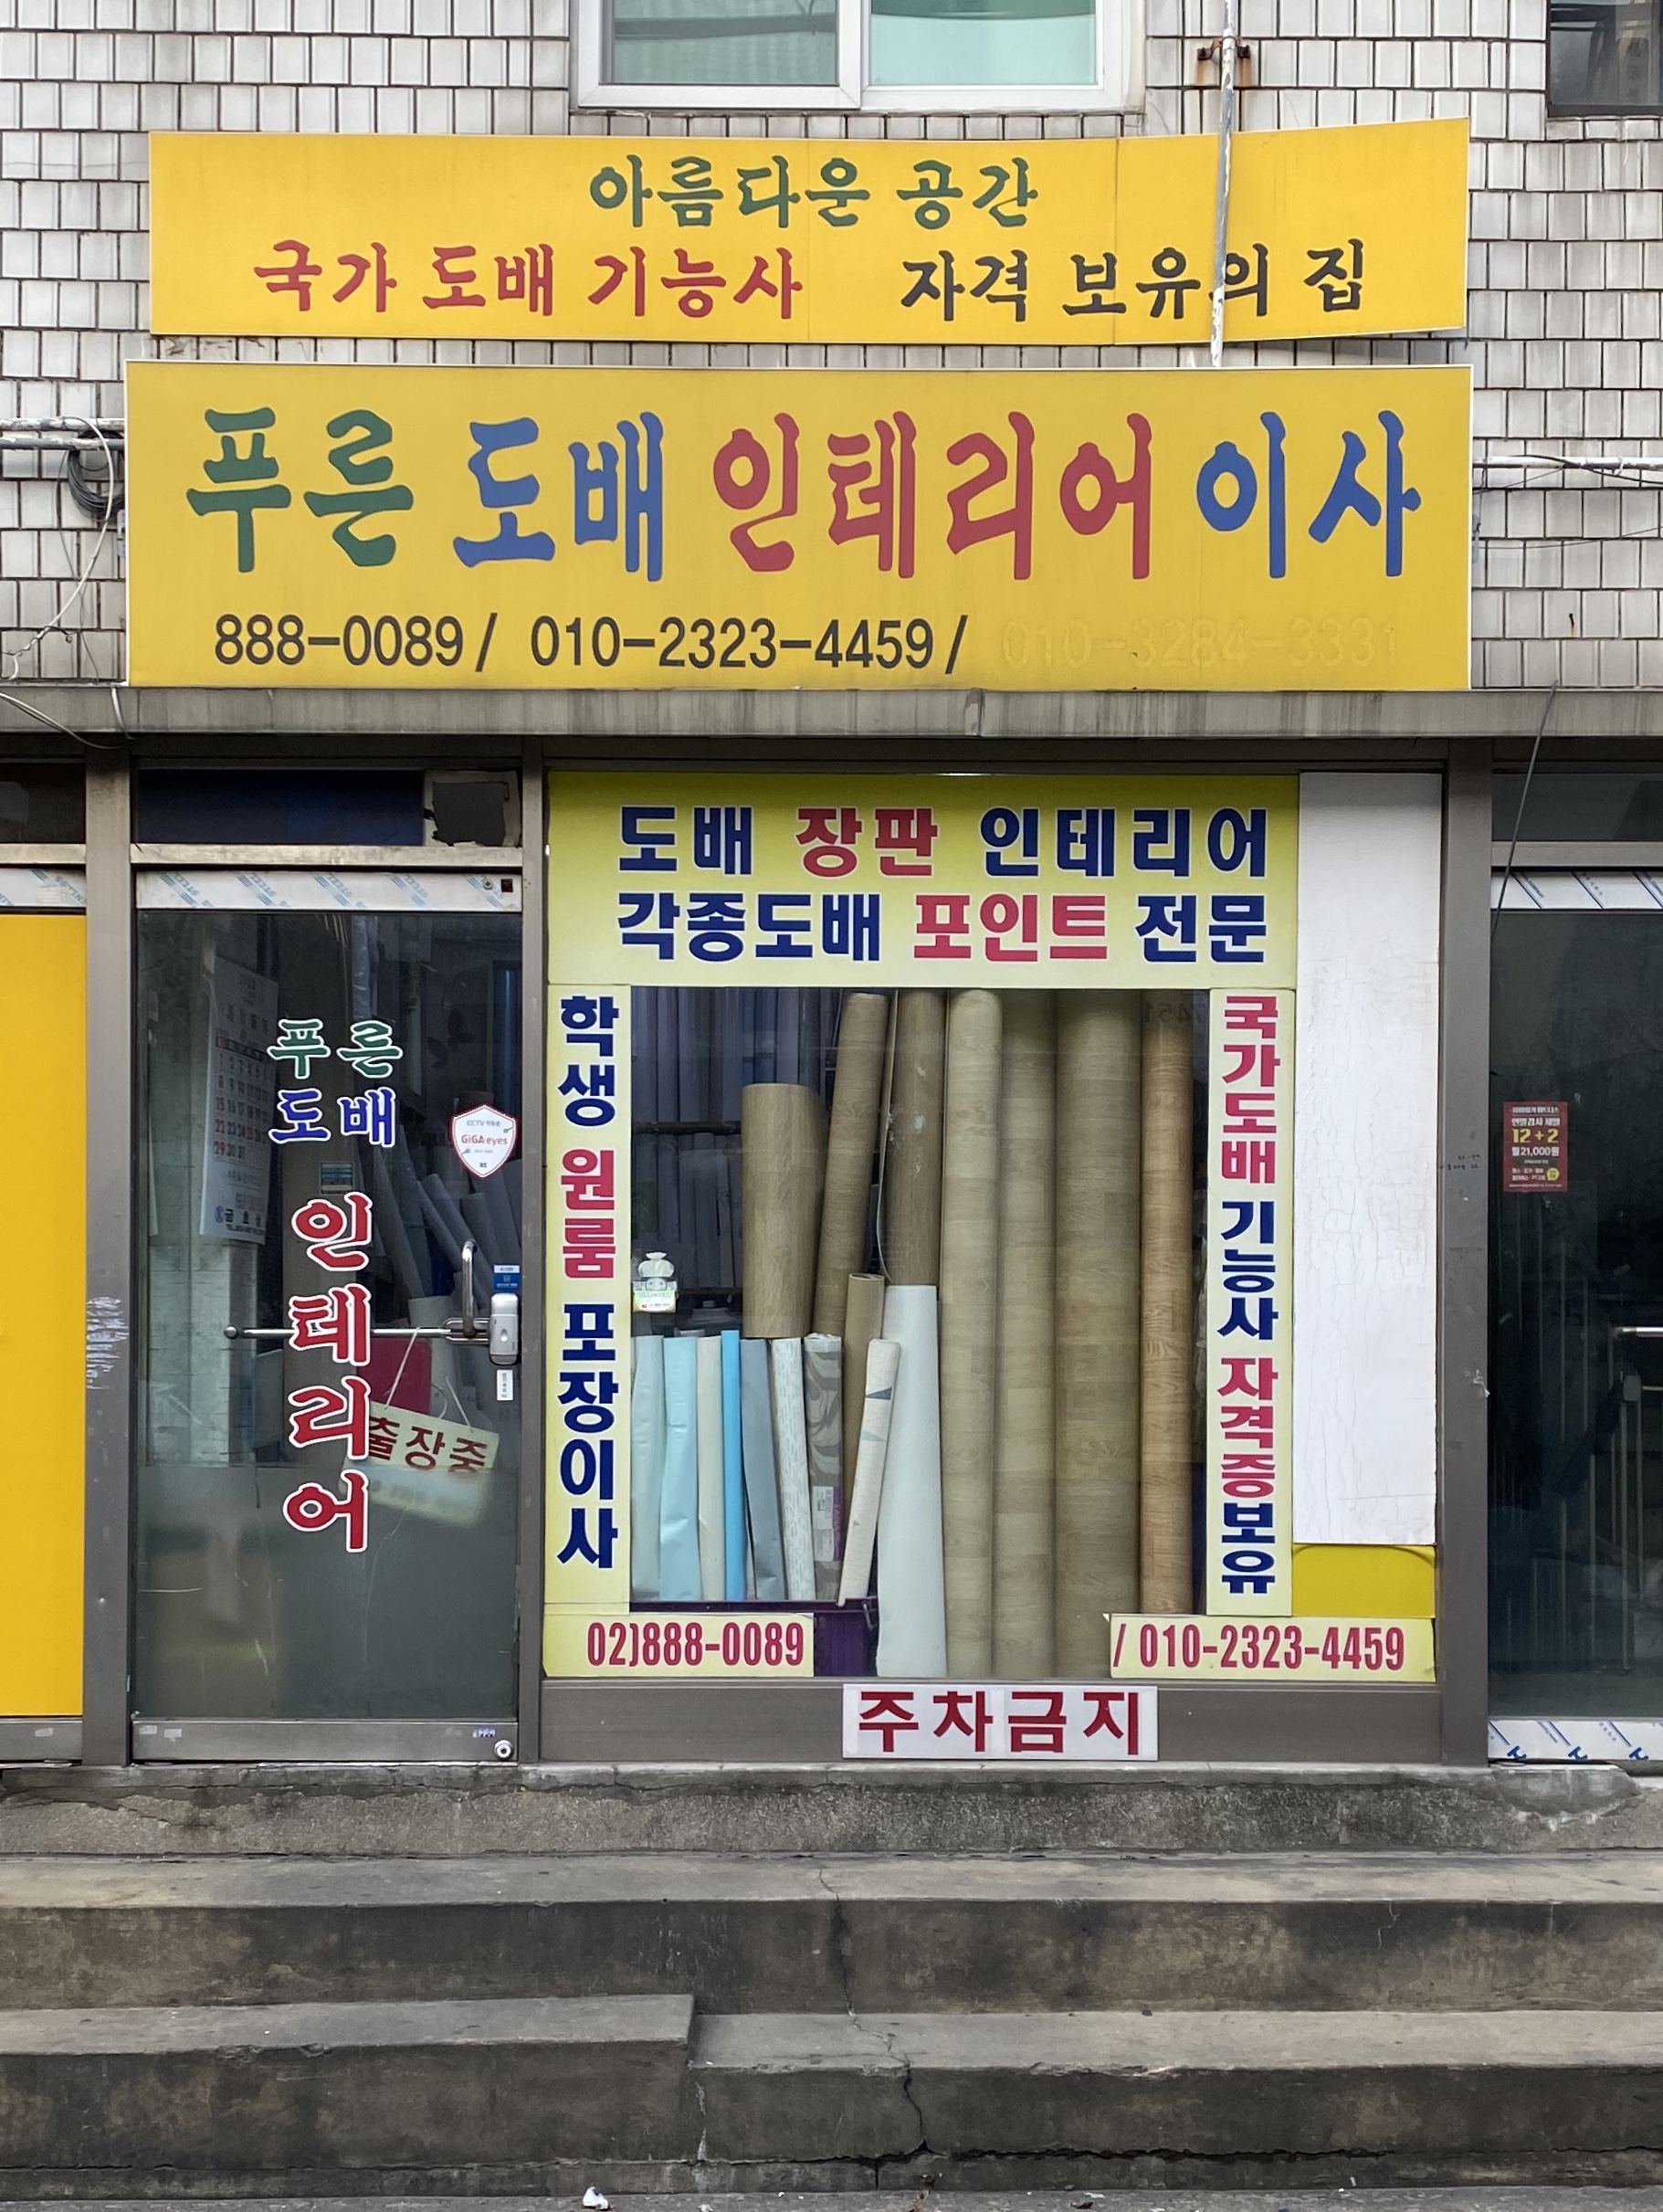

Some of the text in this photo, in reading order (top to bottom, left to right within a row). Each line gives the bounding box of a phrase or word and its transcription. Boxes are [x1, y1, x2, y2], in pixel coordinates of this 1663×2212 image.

[589, 154, 1037, 229] 아름다운 공간
[253, 239, 396, 312] 국가
[422, 243, 553, 316] 도배
[586, 246, 803, 320] 기능사
[900, 248, 1028, 322] 자격
[1303, 238, 1363, 312] 집
[186, 406, 1421, 582] 푸른 도배 인테리어 이사
[618, 805, 1268, 879] 도배 장판 인테리어
[617, 892, 1266, 963] 각종도배 포인트 전문
[267, 1018, 403, 1079] 푸른
[268, 1087, 396, 1148] 도배
[557, 995, 620, 1569] 학생 원룸 포장이사
[1217, 995, 1280, 1594] 국가도배 기능사 자격증보유
[283, 1191, 372, 1553] 인테리어
[587, 1621, 805, 1668] 02)888-0089
[1140, 1623, 1405, 1671] 010-2323-4459
[858, 1691, 1140, 1756] 주차금지
